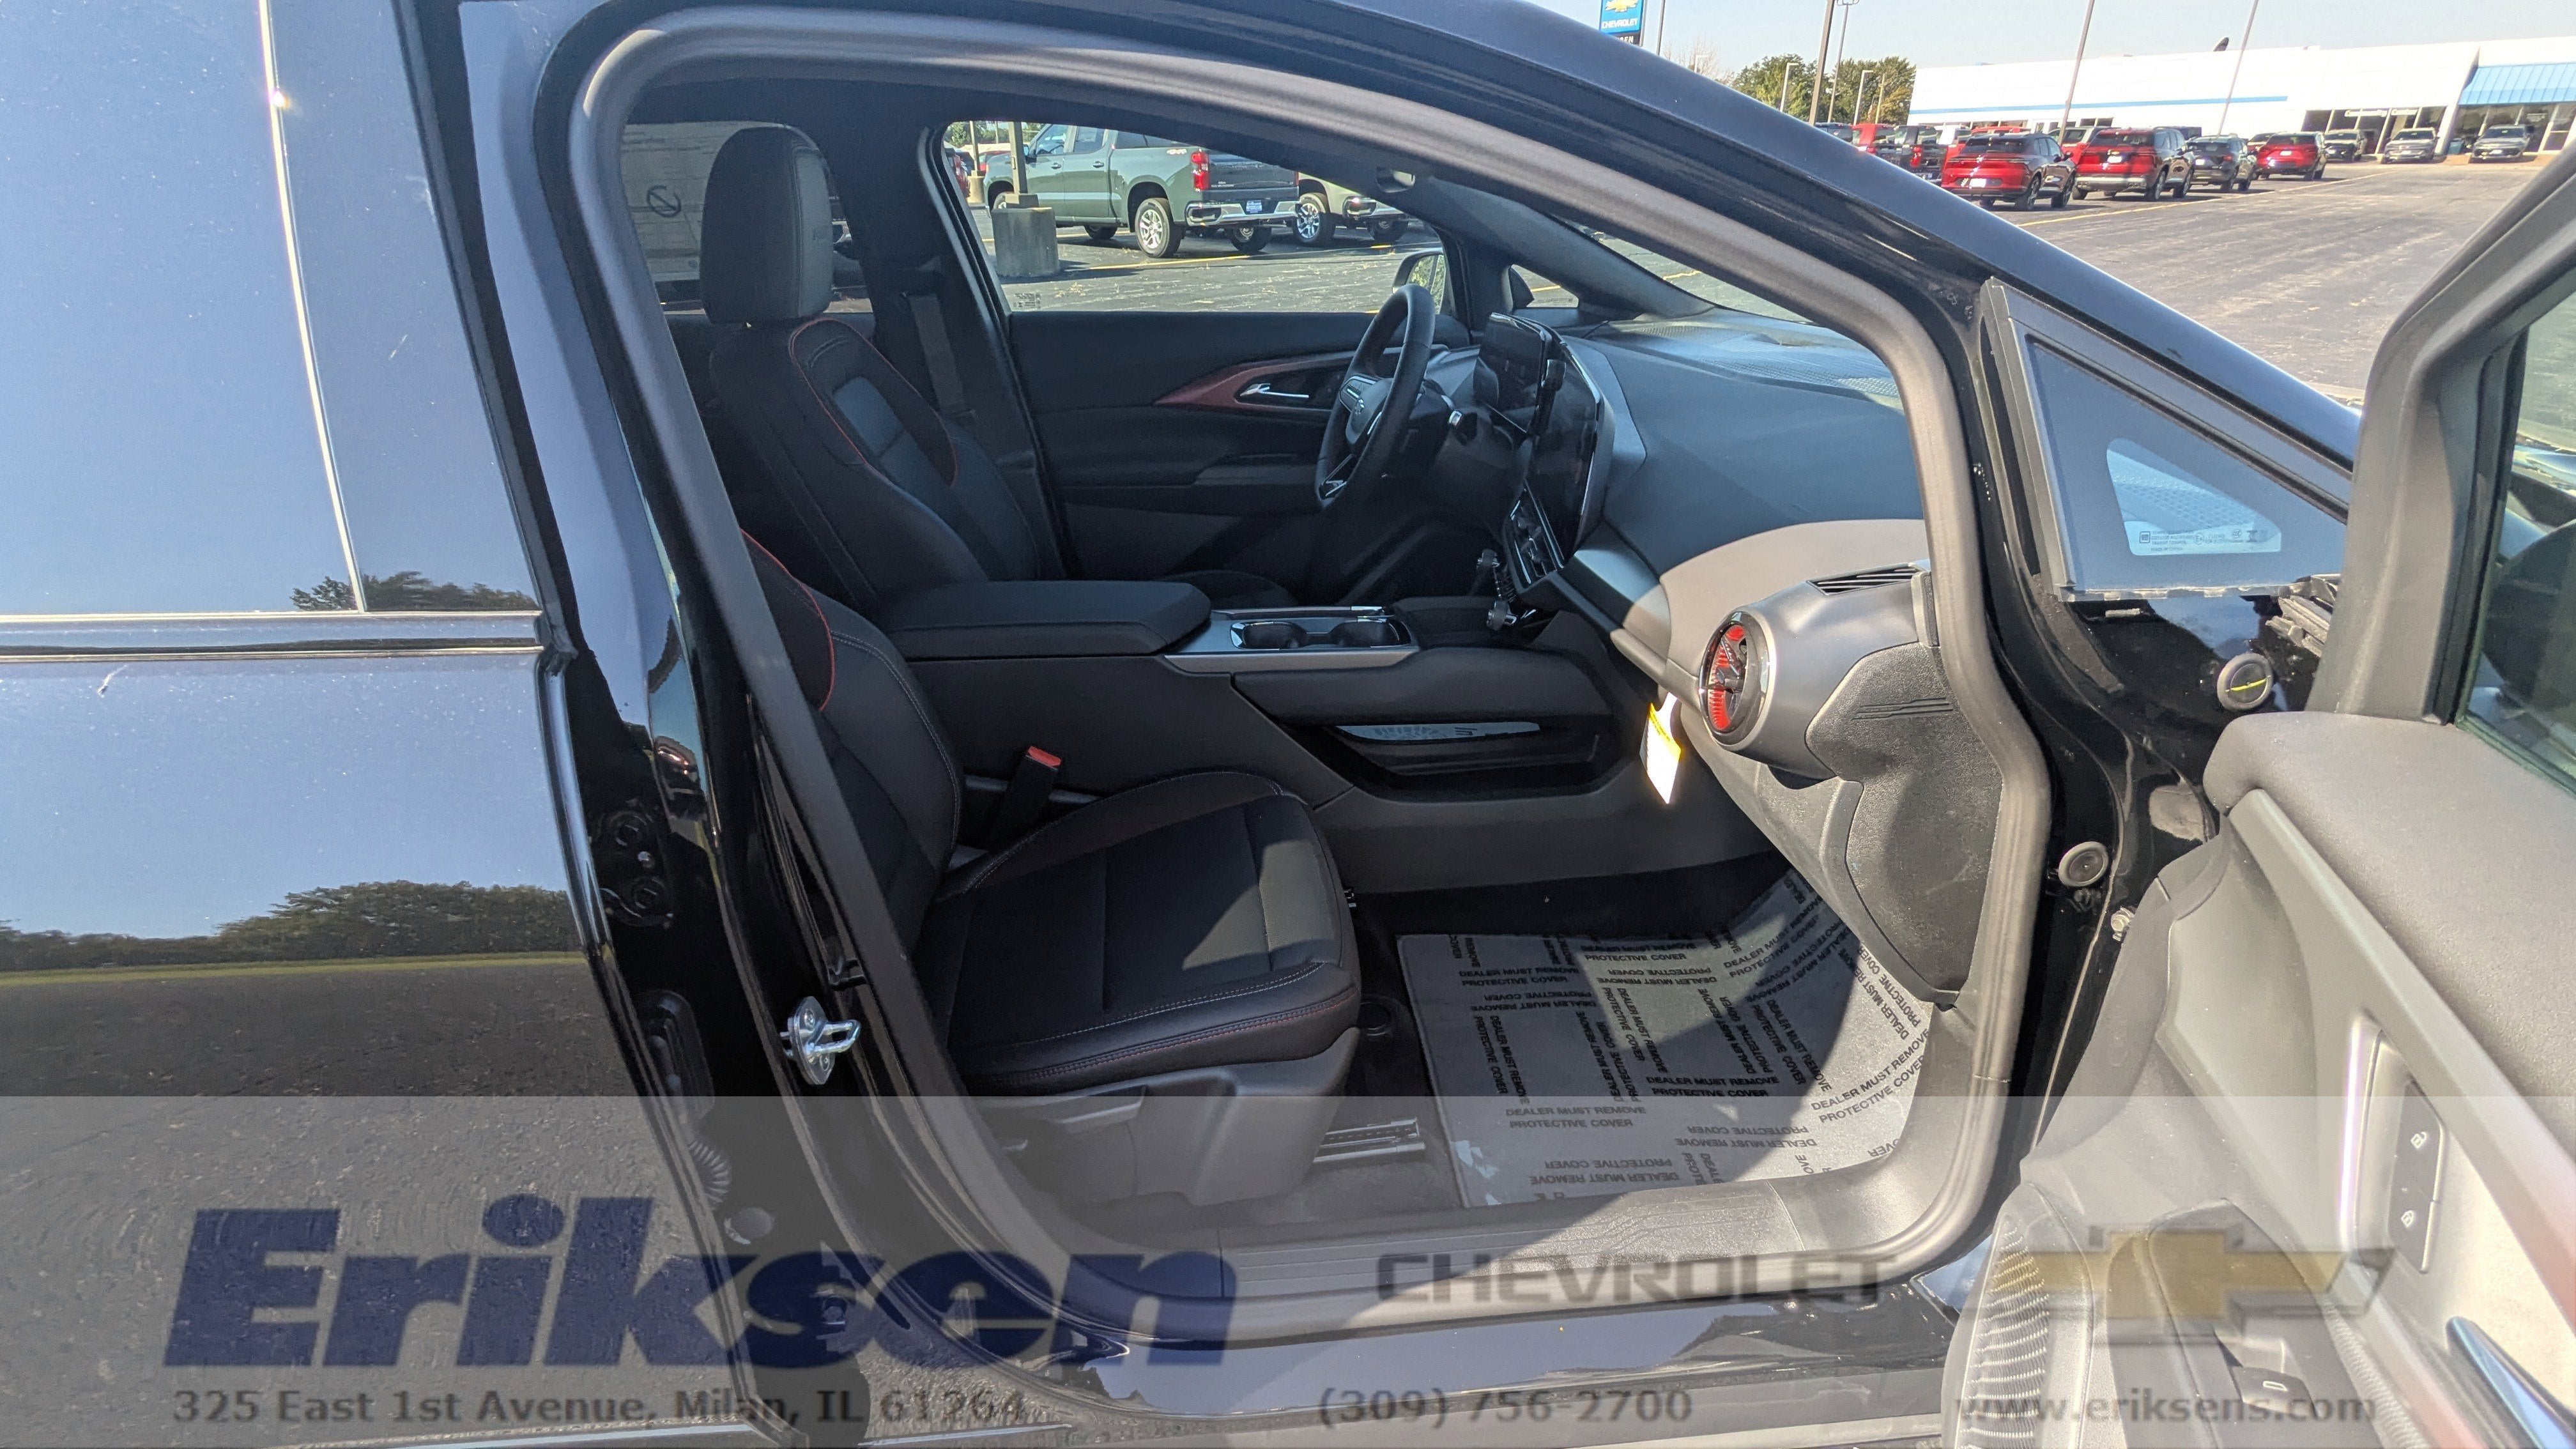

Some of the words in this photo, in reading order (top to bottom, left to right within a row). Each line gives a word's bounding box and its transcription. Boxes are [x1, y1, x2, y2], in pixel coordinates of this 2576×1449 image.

[1724, 947, 1764, 968] DEALER
[1764, 929, 1790, 949] MUST
[1857, 946, 1880, 975] COVER
[1862, 981, 1885, 1006] MUST
[1879, 974, 1921, 1027] PROTECTIVE
[1616, 988, 1638, 1015] DEALER
[1632, 1016, 1651, 1038] MUST
[1602, 988, 1632, 1031] PROTECTIVE
[1625, 1034, 1646, 1061] COVER
[1880, 1003, 1910, 1040] DEALER
[1802, 1054, 1832, 1092] REMOVE
[1646, 1077, 1692, 1085] DEALER
[1729, 1077, 1780, 1085] REMOVE
[1652, 1087, 1725, 1097] PROTECTIVE
[1811, 1088, 1860, 1111] DEALER
[1859, 1066, 1891, 1092] MUST
[1819, 1085, 1894, 1123] PROTECTIVE
[1506, 1107, 1554, 1116] DEALER
[1509, 1119, 1588, 1128] PROTECTIVE
[1590, 1119, 1634, 1128] COVER
[1731, 1126, 1809, 1135] PROTECTIVE
[1675, 1138, 1728, 1147] REMOVE
[1767, 1139, 1817, 1148] DEALER
[1868, 1138, 1900, 1157] OVER
[1545, 1160, 1590, 1169] COVER
[1594, 1158, 1673, 1168] PROTECTIVE
[1529, 1174, 1585, 1184] REMOVE
[1590, 1174, 1625, 1183] MUST
[1627, 1172, 1680, 1182] DEALER
